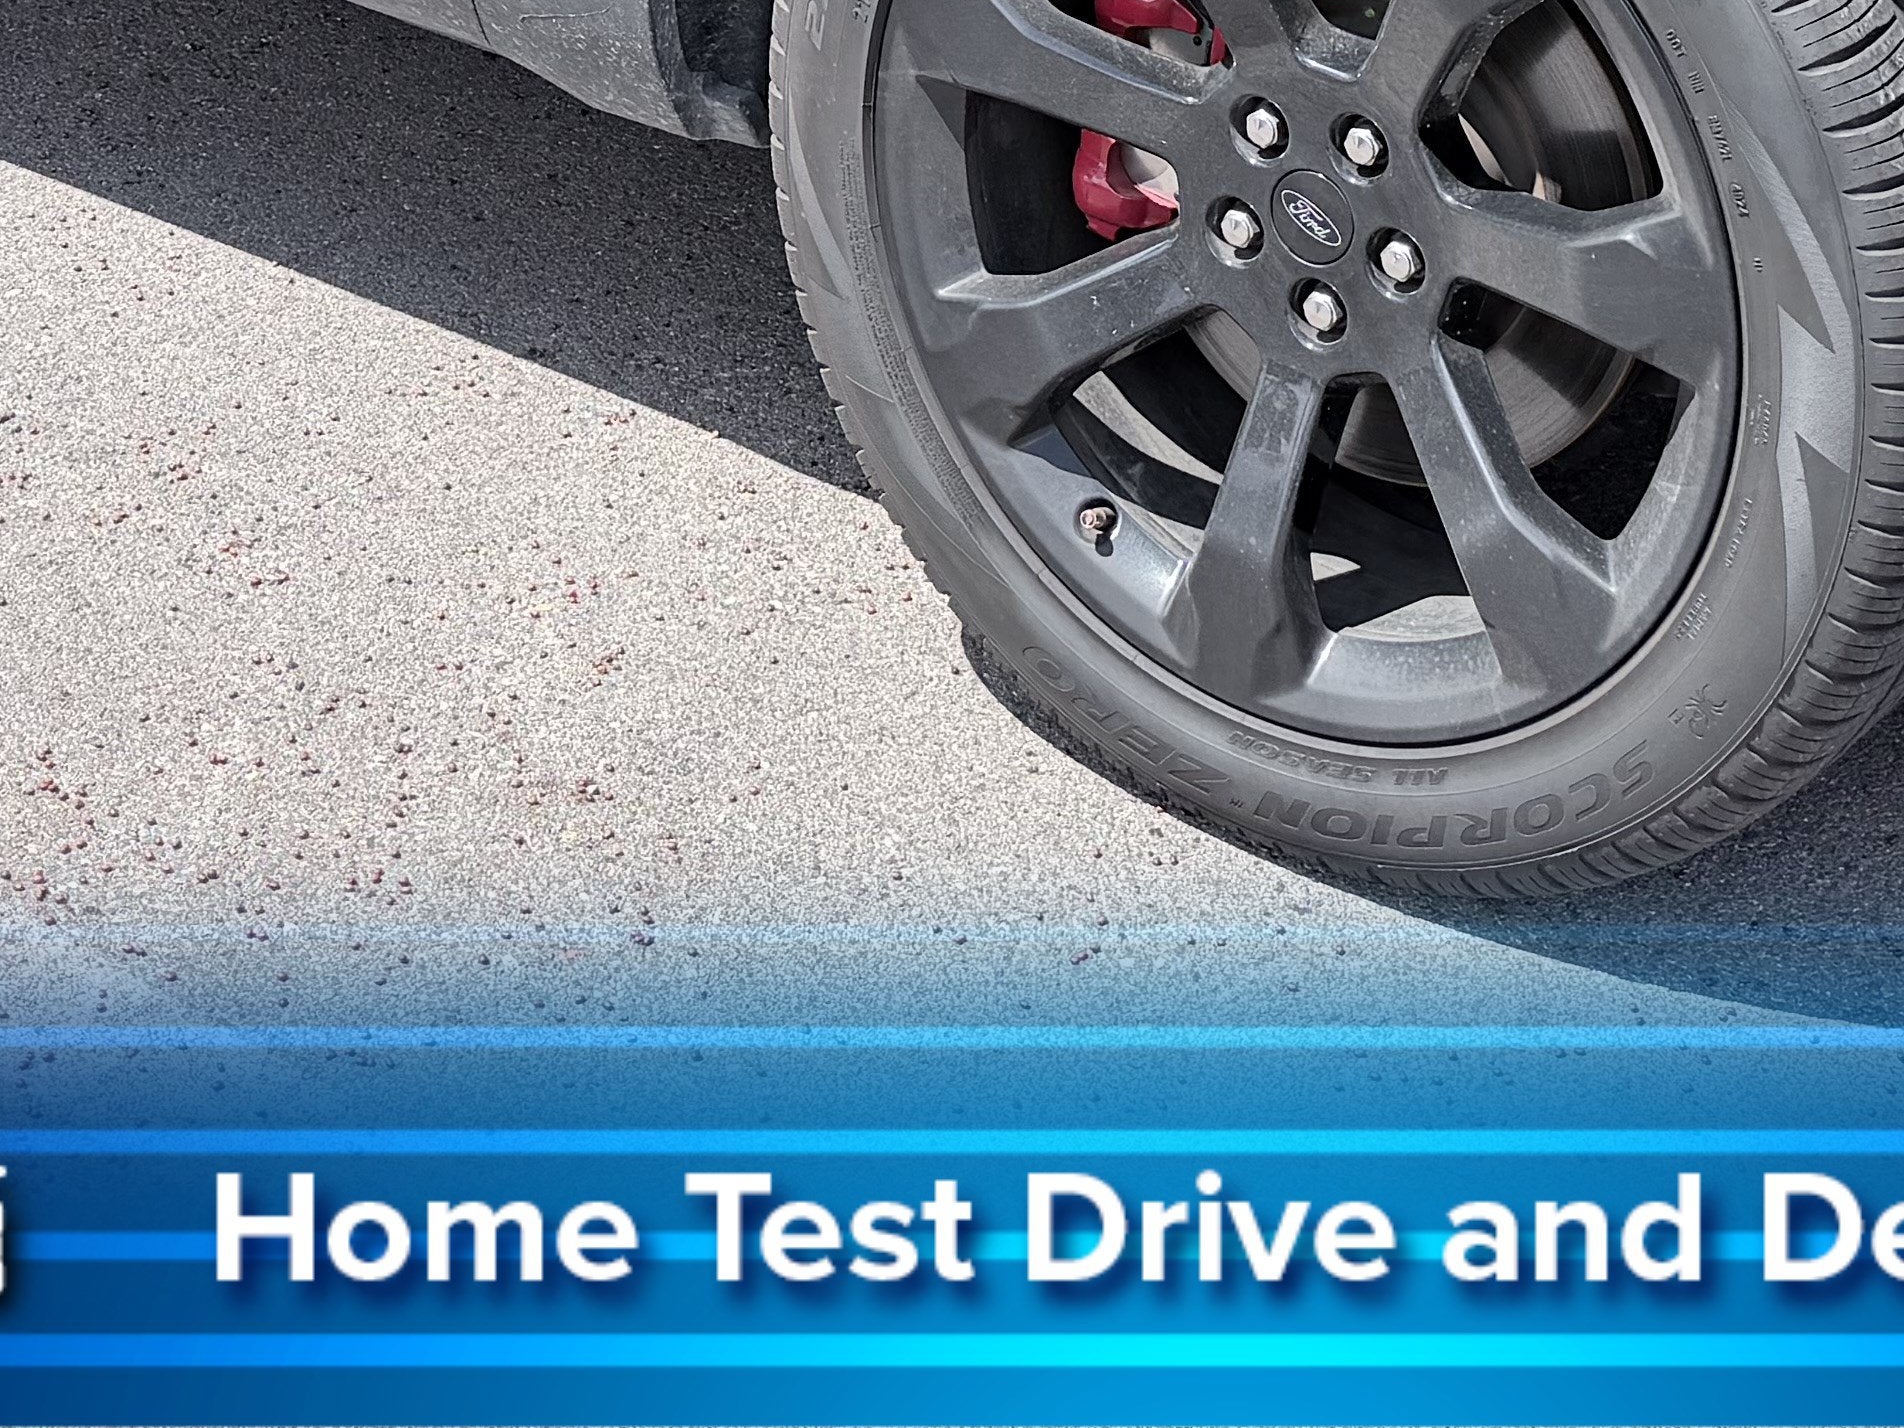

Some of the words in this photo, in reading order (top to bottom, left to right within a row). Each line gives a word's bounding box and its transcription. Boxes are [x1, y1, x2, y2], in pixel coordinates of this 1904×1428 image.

[1288, 198, 1332, 240] Ford
[1021, 644, 1234, 796] ZERO
[1226, 729, 1378, 786] SEASON
[1389, 765, 1449, 788] ALL
[1252, 737, 1656, 850] SCORPION
